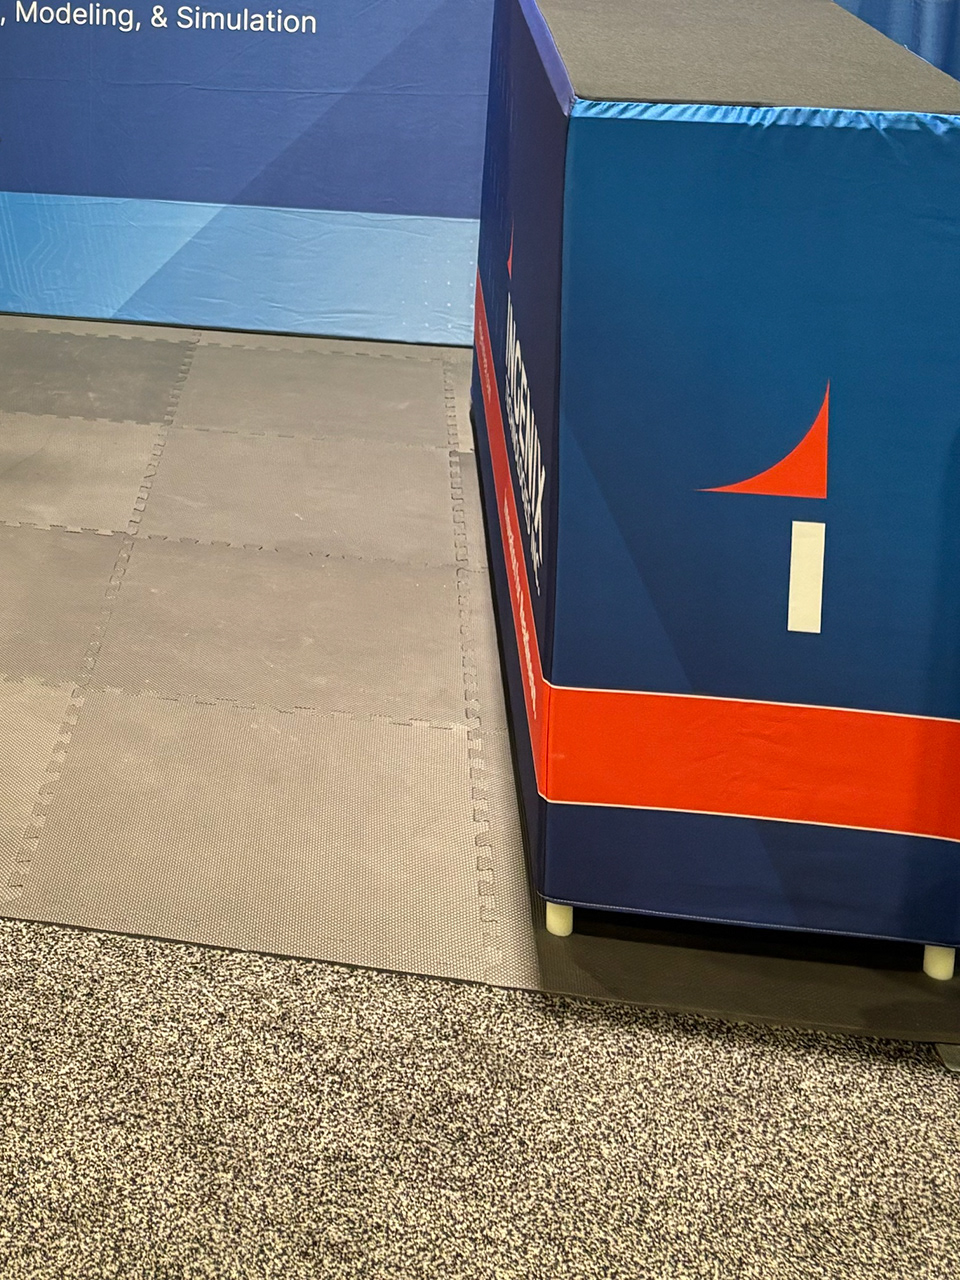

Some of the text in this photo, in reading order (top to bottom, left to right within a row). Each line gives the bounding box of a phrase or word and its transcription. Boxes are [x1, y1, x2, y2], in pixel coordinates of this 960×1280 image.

[16, 0, 141, 32] Modeling,
[150, 4, 168, 28] &
[177, 5, 317, 34] Simulation
[505, 290, 546, 566] INGENIX
